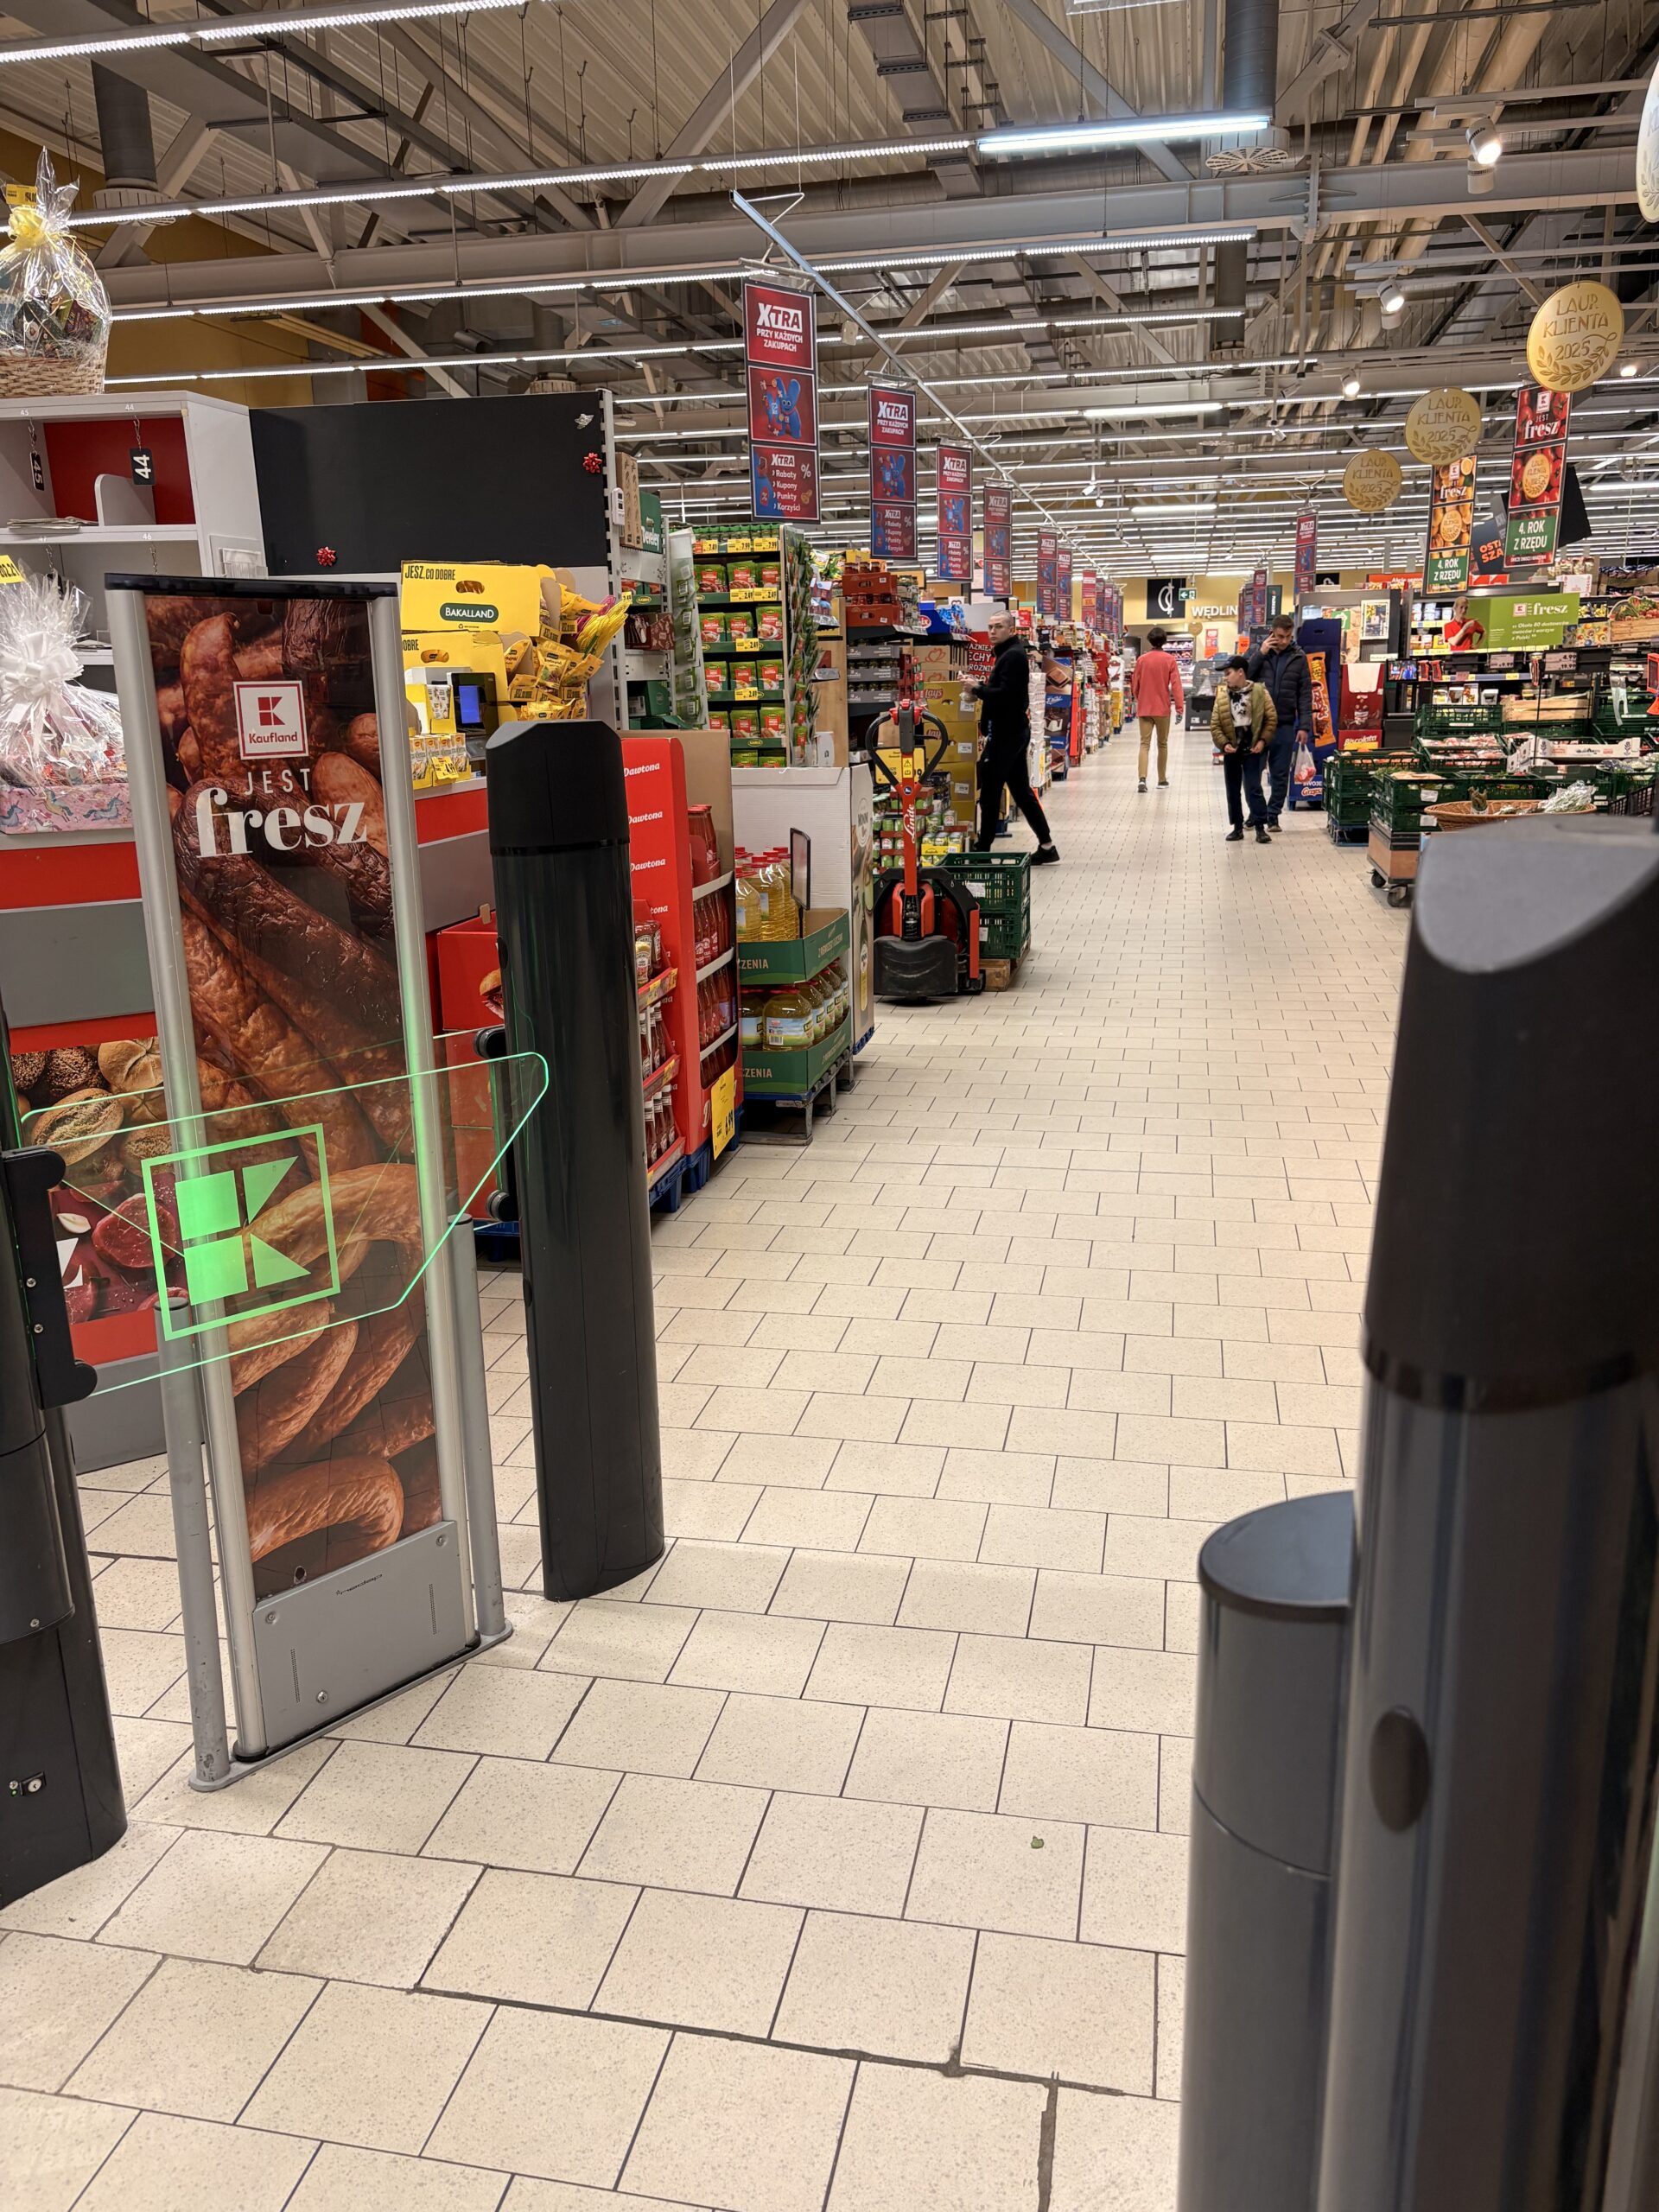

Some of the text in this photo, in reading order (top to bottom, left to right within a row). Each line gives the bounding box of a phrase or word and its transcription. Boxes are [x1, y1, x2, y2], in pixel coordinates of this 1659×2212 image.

[757, 302, 803, 333] XTRA
[1543, 312, 1609, 338] KLIENTA
[756, 328, 804, 344] PRZY KAŻDYCH
[763, 339, 797, 353] ZAKUPACH
[1555, 340, 1591, 360] 2025
[877, 401, 909, 421] XTRA
[1417, 411, 1471, 426] KLIENTA
[1535, 414, 1549, 423] JEST
[1427, 429, 1456, 443] 2025
[1524, 420, 1560, 440] fresz
[132, 454, 152, 480] 44
[771, 454, 795, 467] XTRA
[943, 456, 967, 473] XTRA
[34, 460, 43, 484] 45
[776, 469, 796, 480] Rabaty
[1352, 469, 1394, 480] KLIENTA
[776, 480, 798, 491] Kupony
[1360, 484, 1382, 493] 2025
[1440, 485, 1467, 500] fresz
[777, 492, 797, 502] Punkty
[778, 503, 801, 512] Korzyści
[885, 509, 901, 518] XTRA
[1518, 520, 1545, 535] 4. ROK
[1514, 536, 1548, 552] Z RZĘDU
[1445, 558, 1459, 569] ROK
[426, 569, 434, 580] CO
[435, 569, 455, 581] DOBRE
[1433, 569, 1461, 582] Z RZĘDU
[445, 607, 494, 619] BAKALLAND
[1533, 602, 1568, 615] fresz
[403, 639, 420, 651] OBRE
[249, 731, 298, 744] Kaufland
[623, 762, 660, 777] Dawtona
[245, 768, 310, 795] JEST
[192, 787, 368, 858] fresz
[904, 804, 915, 843] Linde
[630, 858, 665, 872] Dawtona
[650, 904, 668, 915] tona
[742, 1068, 772, 1078] ZENIA
